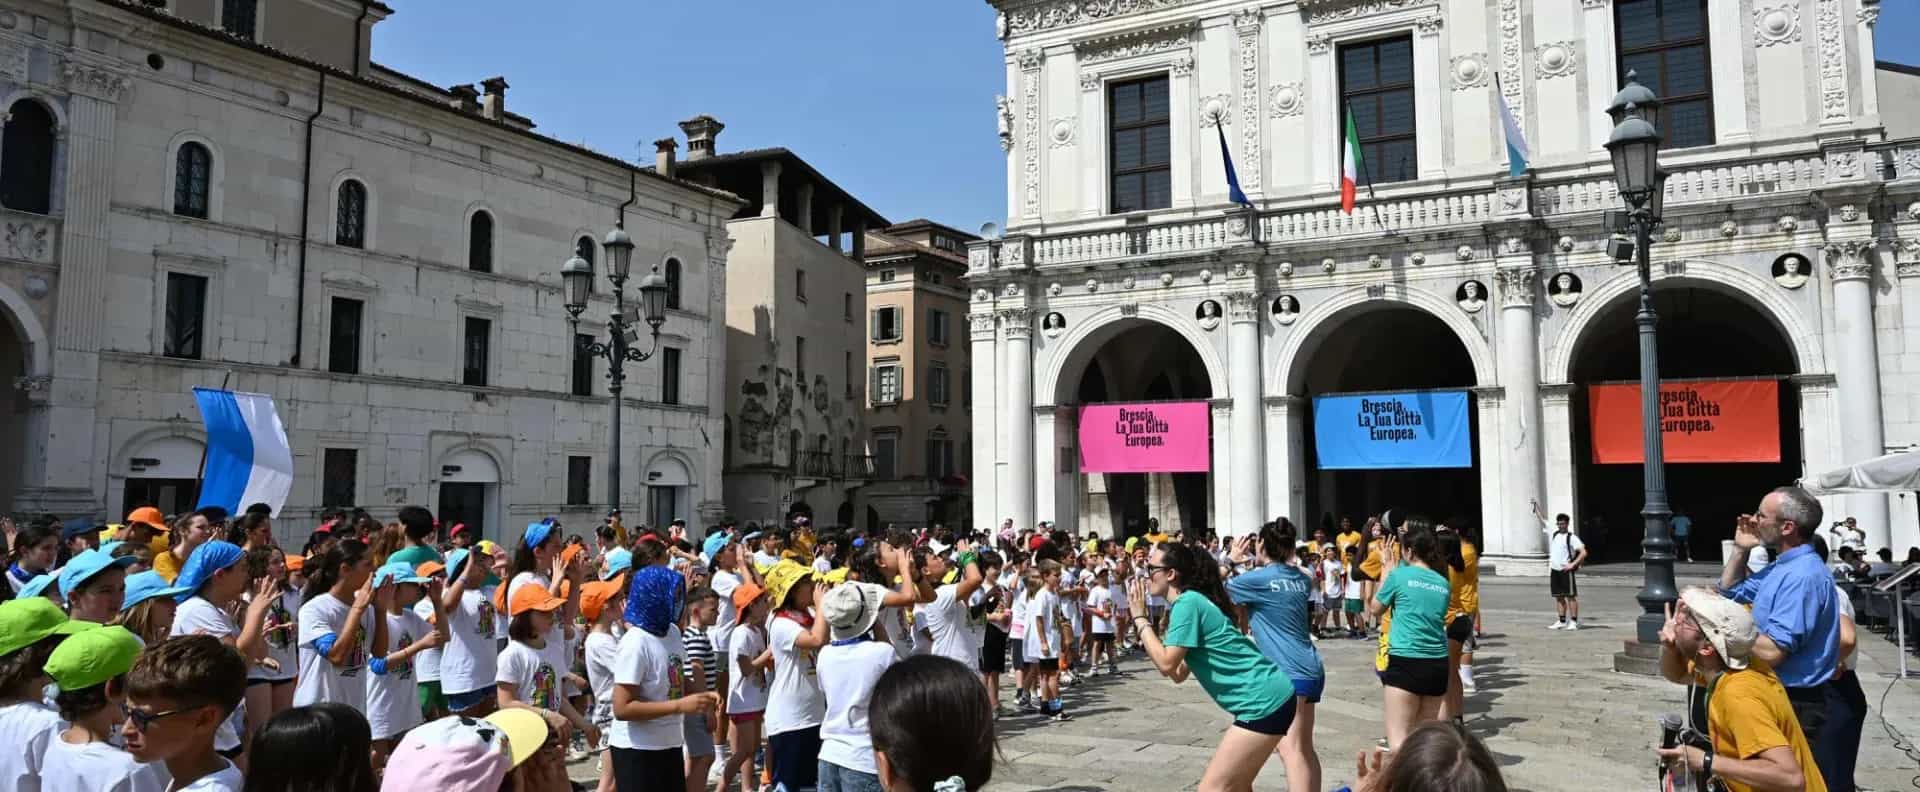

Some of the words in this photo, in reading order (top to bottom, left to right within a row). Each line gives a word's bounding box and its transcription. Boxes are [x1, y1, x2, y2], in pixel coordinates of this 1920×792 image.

[1659, 387, 1702, 402] rescia,
[1662, 401, 1683, 416] Tua
[1688, 400, 1720, 416] Città
[1358, 413, 1370, 427] La
[1373, 412, 1391, 426] Tua
[1394, 410, 1422, 425] Città
[1116, 421, 1126, 434] La
[1128, 420, 1144, 433] Tua
[1146, 419, 1169, 433] Città
[1126, 433, 1165, 448] Europea.
[1370, 426, 1417, 443] Europea.
